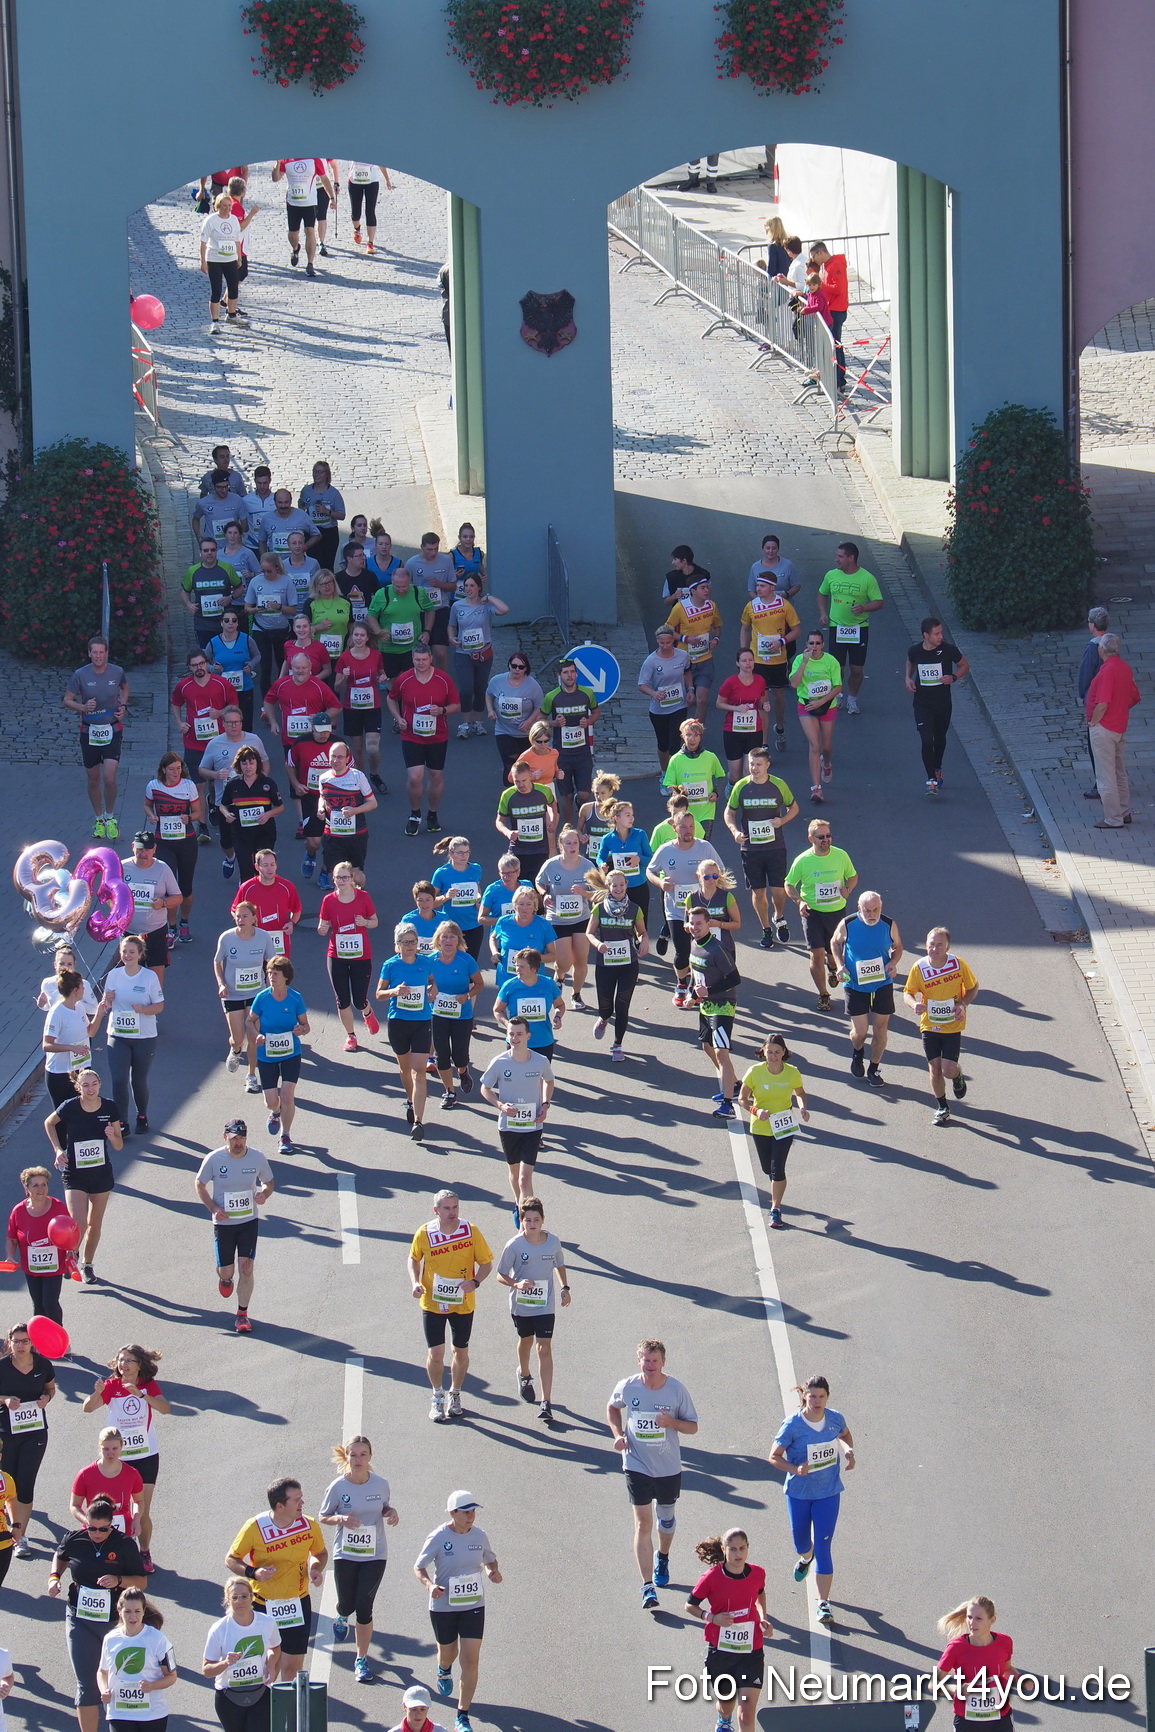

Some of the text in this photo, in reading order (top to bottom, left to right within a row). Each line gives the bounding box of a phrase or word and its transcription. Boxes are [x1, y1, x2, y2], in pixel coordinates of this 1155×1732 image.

[464, 634, 480, 643] 5057
[922, 669, 939, 677] 5183
[812, 685, 828, 694] 5028
[502, 702, 519, 710] 5098
[556, 705, 586, 714] BOCK
[198, 723, 215, 732] 5114
[565, 731, 582, 739] 5149
[243, 808, 261, 817] 5128
[512, 804, 546, 815] BOCK
[164, 822, 182, 830] 5139
[752, 826, 770, 835] 5146
[456, 889, 474, 898] 5042
[819, 887, 837, 896] 5217
[560, 901, 579, 910] 5032
[340, 941, 359, 949] 5115
[608, 947, 626, 956] 5145
[860, 964, 881, 974] 5208
[239, 973, 258, 982] 5218
[925, 973, 962, 989] MAX BÖGL
[438, 1000, 458, 1009] 5035
[521, 1005, 541, 1013] 5041
[931, 1006, 951, 1015] 5088
[116, 1017, 135, 1026] 5103
[269, 1039, 290, 1048] 5040
[774, 1116, 792, 1128] 5151
[80, 1147, 100, 1157] 5082
[229, 1198, 250, 1208] 5198
[431, 1241, 473, 1257] MAX BÖGL
[32, 1253, 53, 1262] 5127
[437, 1284, 459, 1294] 5097
[14, 1410, 38, 1422] 5034
[812, 1448, 834, 1460] 5169
[266, 1533, 313, 1553] MAX BÖGL
[347, 1534, 371, 1544] 5043
[454, 1582, 478, 1593] 5193
[82, 1596, 105, 1609] 5056
[272, 1604, 297, 1617] 5099
[725, 1630, 749, 1641] 5108
[233, 1665, 258, 1678] 5048
[120, 1688, 144, 1700] 5049
